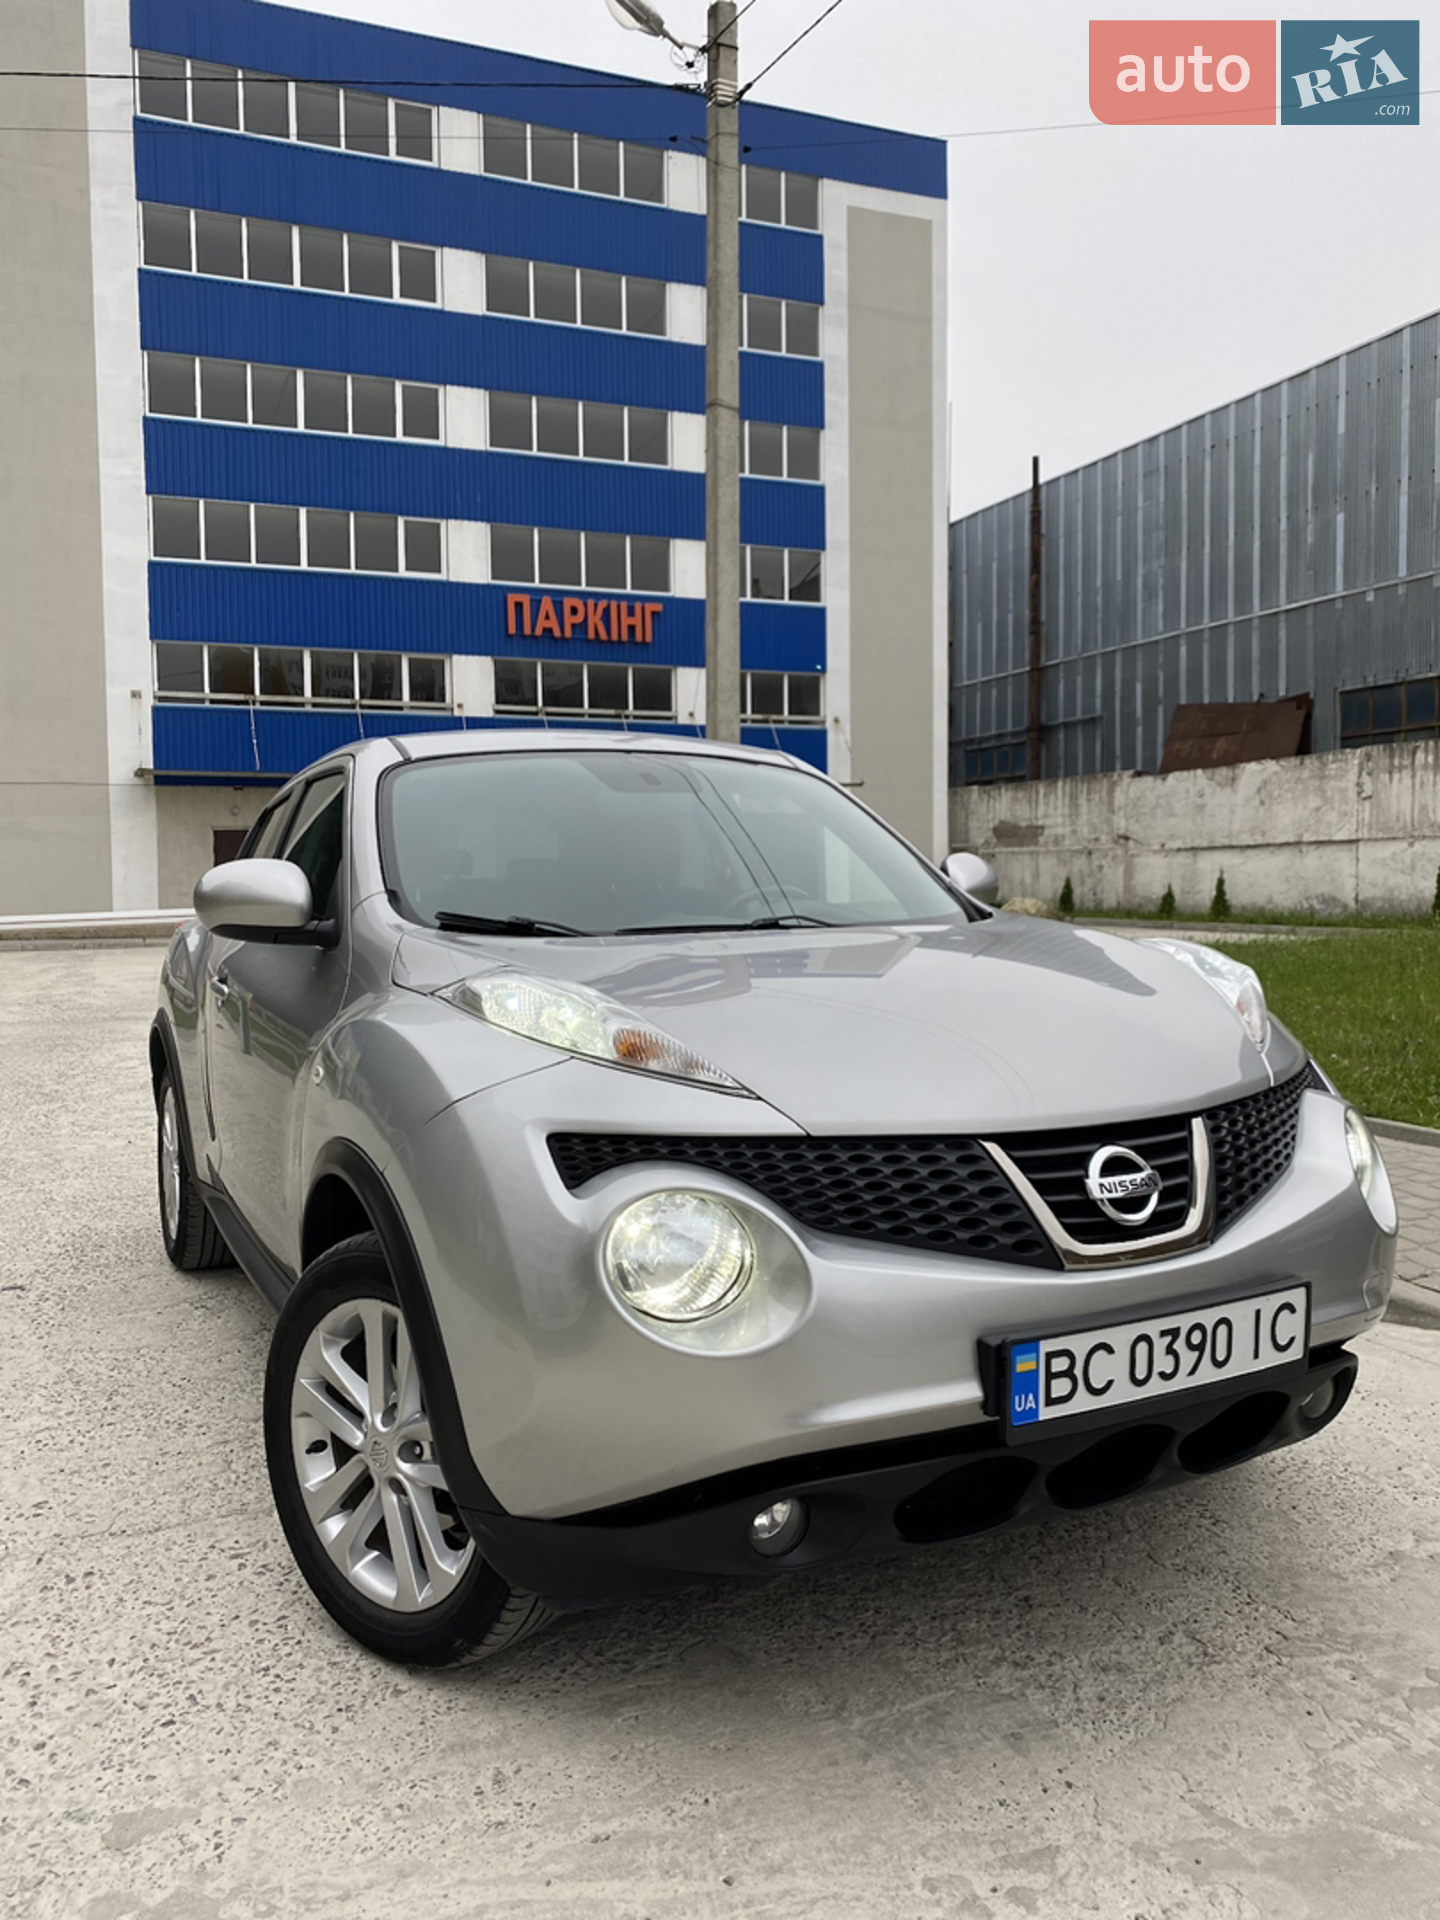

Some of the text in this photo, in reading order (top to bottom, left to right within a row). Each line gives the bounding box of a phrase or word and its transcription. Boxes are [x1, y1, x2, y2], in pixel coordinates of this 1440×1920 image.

[507, 593, 663, 643] ПАРКІНГ
[1099, 1175, 1158, 1195] NISSAN
[1044, 1302, 1297, 1407] BC 0390 IC
[1014, 1393, 1037, 1412] UA
